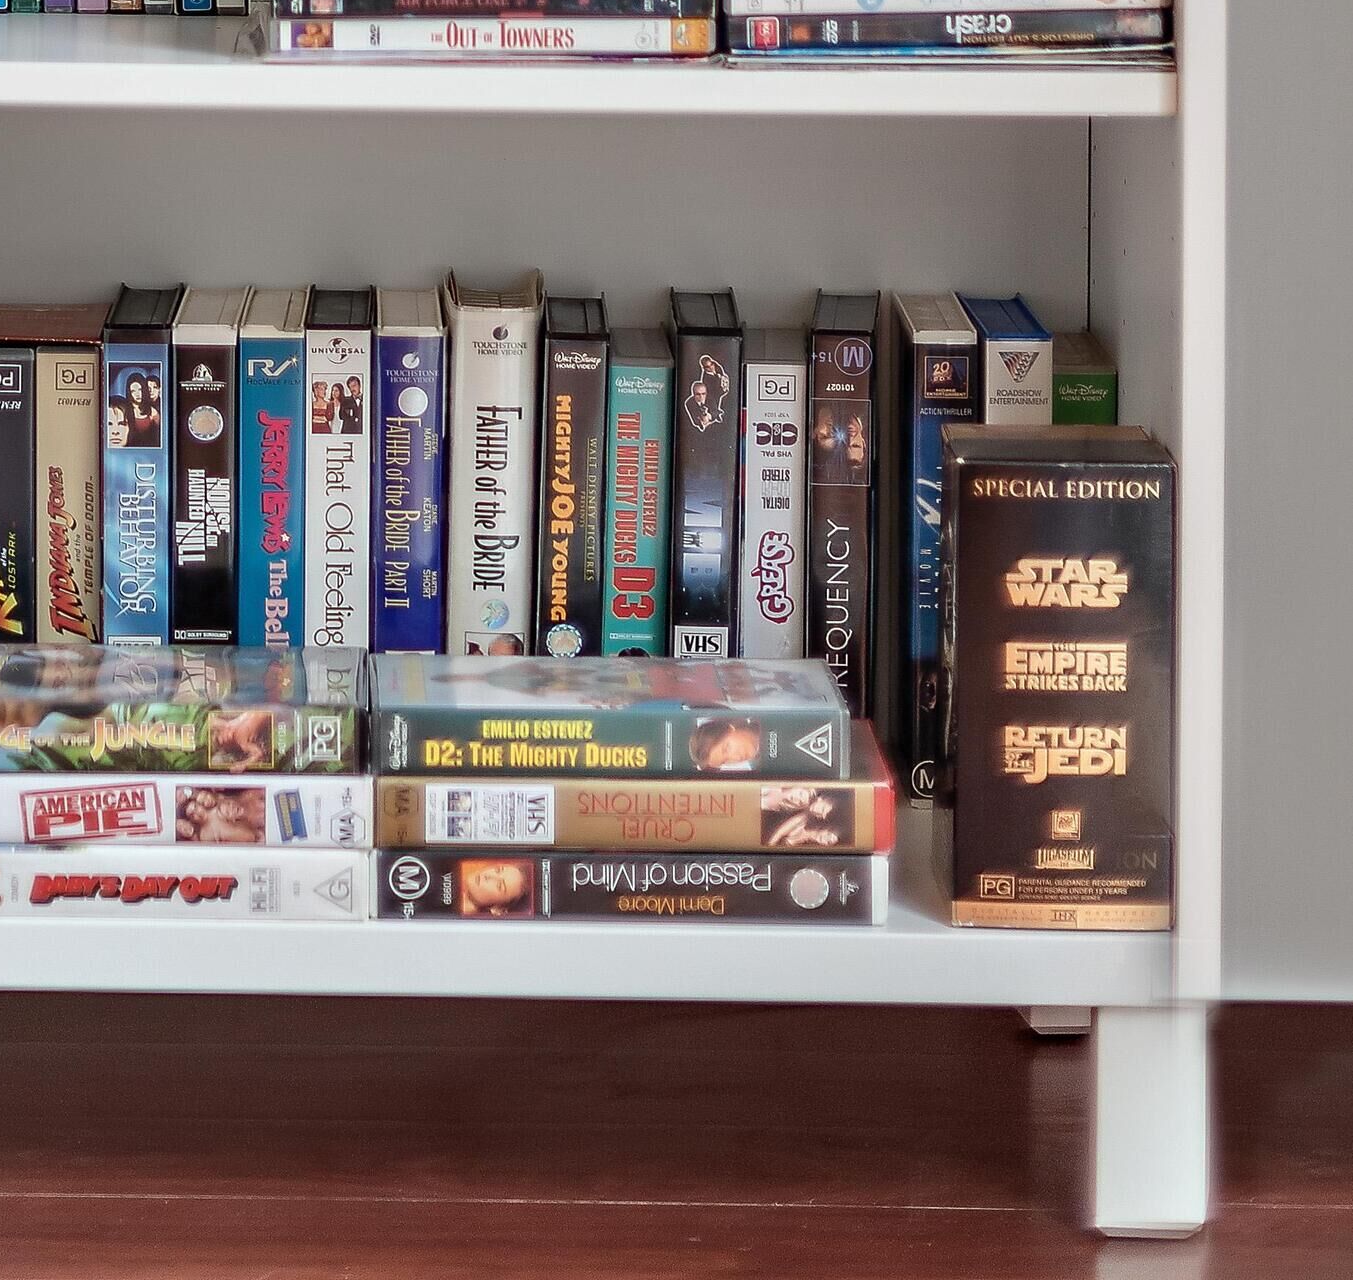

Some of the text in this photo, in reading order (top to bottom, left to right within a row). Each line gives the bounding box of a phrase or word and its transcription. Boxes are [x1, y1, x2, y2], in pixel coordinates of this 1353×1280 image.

[945, 13, 1012, 44] crash
[311, 346, 366, 354] UNIVERSAL
[472, 341, 528, 349] TOUCHSTONE
[989, 396, 1049, 406] ENTERTAINMENT
[996, 389, 1042, 398] ROADSHOW
[919, 407, 973, 416] ACTION/THRILLER
[472, 405, 522, 592] FATHER of the BRIDE
[642, 439, 659, 538] EMILIO ESTEVEZ
[973, 479, 1161, 500] SPECIAL EDITION
[175, 469, 206, 566] HAUNTED HILL
[205, 477, 231, 547] HOUSE ON
[384, 416, 422, 609] FATHER of the BRIDE PART II
[422, 427, 431, 599] MARTIN KEATON SHORT
[550, 394, 575, 622] MIGHTY JOE YOUNG
[585, 437, 598, 582] WALT DISNEY PICTURES
[611, 412, 656, 621] THE MIGHTY DUCKS D3
[85, 481, 95, 595] TEMPLE OF DOOM
[118, 462, 157, 614] DISTURBING BEHAVIOR
[314, 442, 355, 645] That Old Feeling
[8, 531, 16, 589] LOST ARK
[47, 466, 97, 643] INDIANA JONES
[919, 548, 933, 611] MOVIE
[1005, 558, 1127, 584] STAR
[1005, 582, 1128, 608] WARS
[682, 633, 719, 651] VHS
[1004, 642, 1127, 675] EMPIRE
[1004, 673, 1127, 692] STRIKES BACK
[34, 737, 56, 747] OF
[63, 735, 90, 747] THE
[90, 717, 196, 761] JUNGLE
[481, 720, 593, 739] EMILIO ESTEVEZ
[1004, 724, 1127, 748] RETURN
[425, 742, 463, 767] D2:
[468, 743, 507, 767] THE
[513, 742, 578, 768] MIGHTY
[585, 743, 647, 768] DUCKS
[31, 789, 146, 816] AMERICAN
[577, 789, 736, 815] INTENTIONS
[35, 809, 149, 837] PIE
[618, 821, 695, 843] CRUEL
[30, 873, 239, 904] BABY'S DAY OUT
[571, 862, 774, 892] Passion of Mind
[1018, 878, 1052, 886] PARENTAL
[618, 895, 726, 916] Demi Moore
